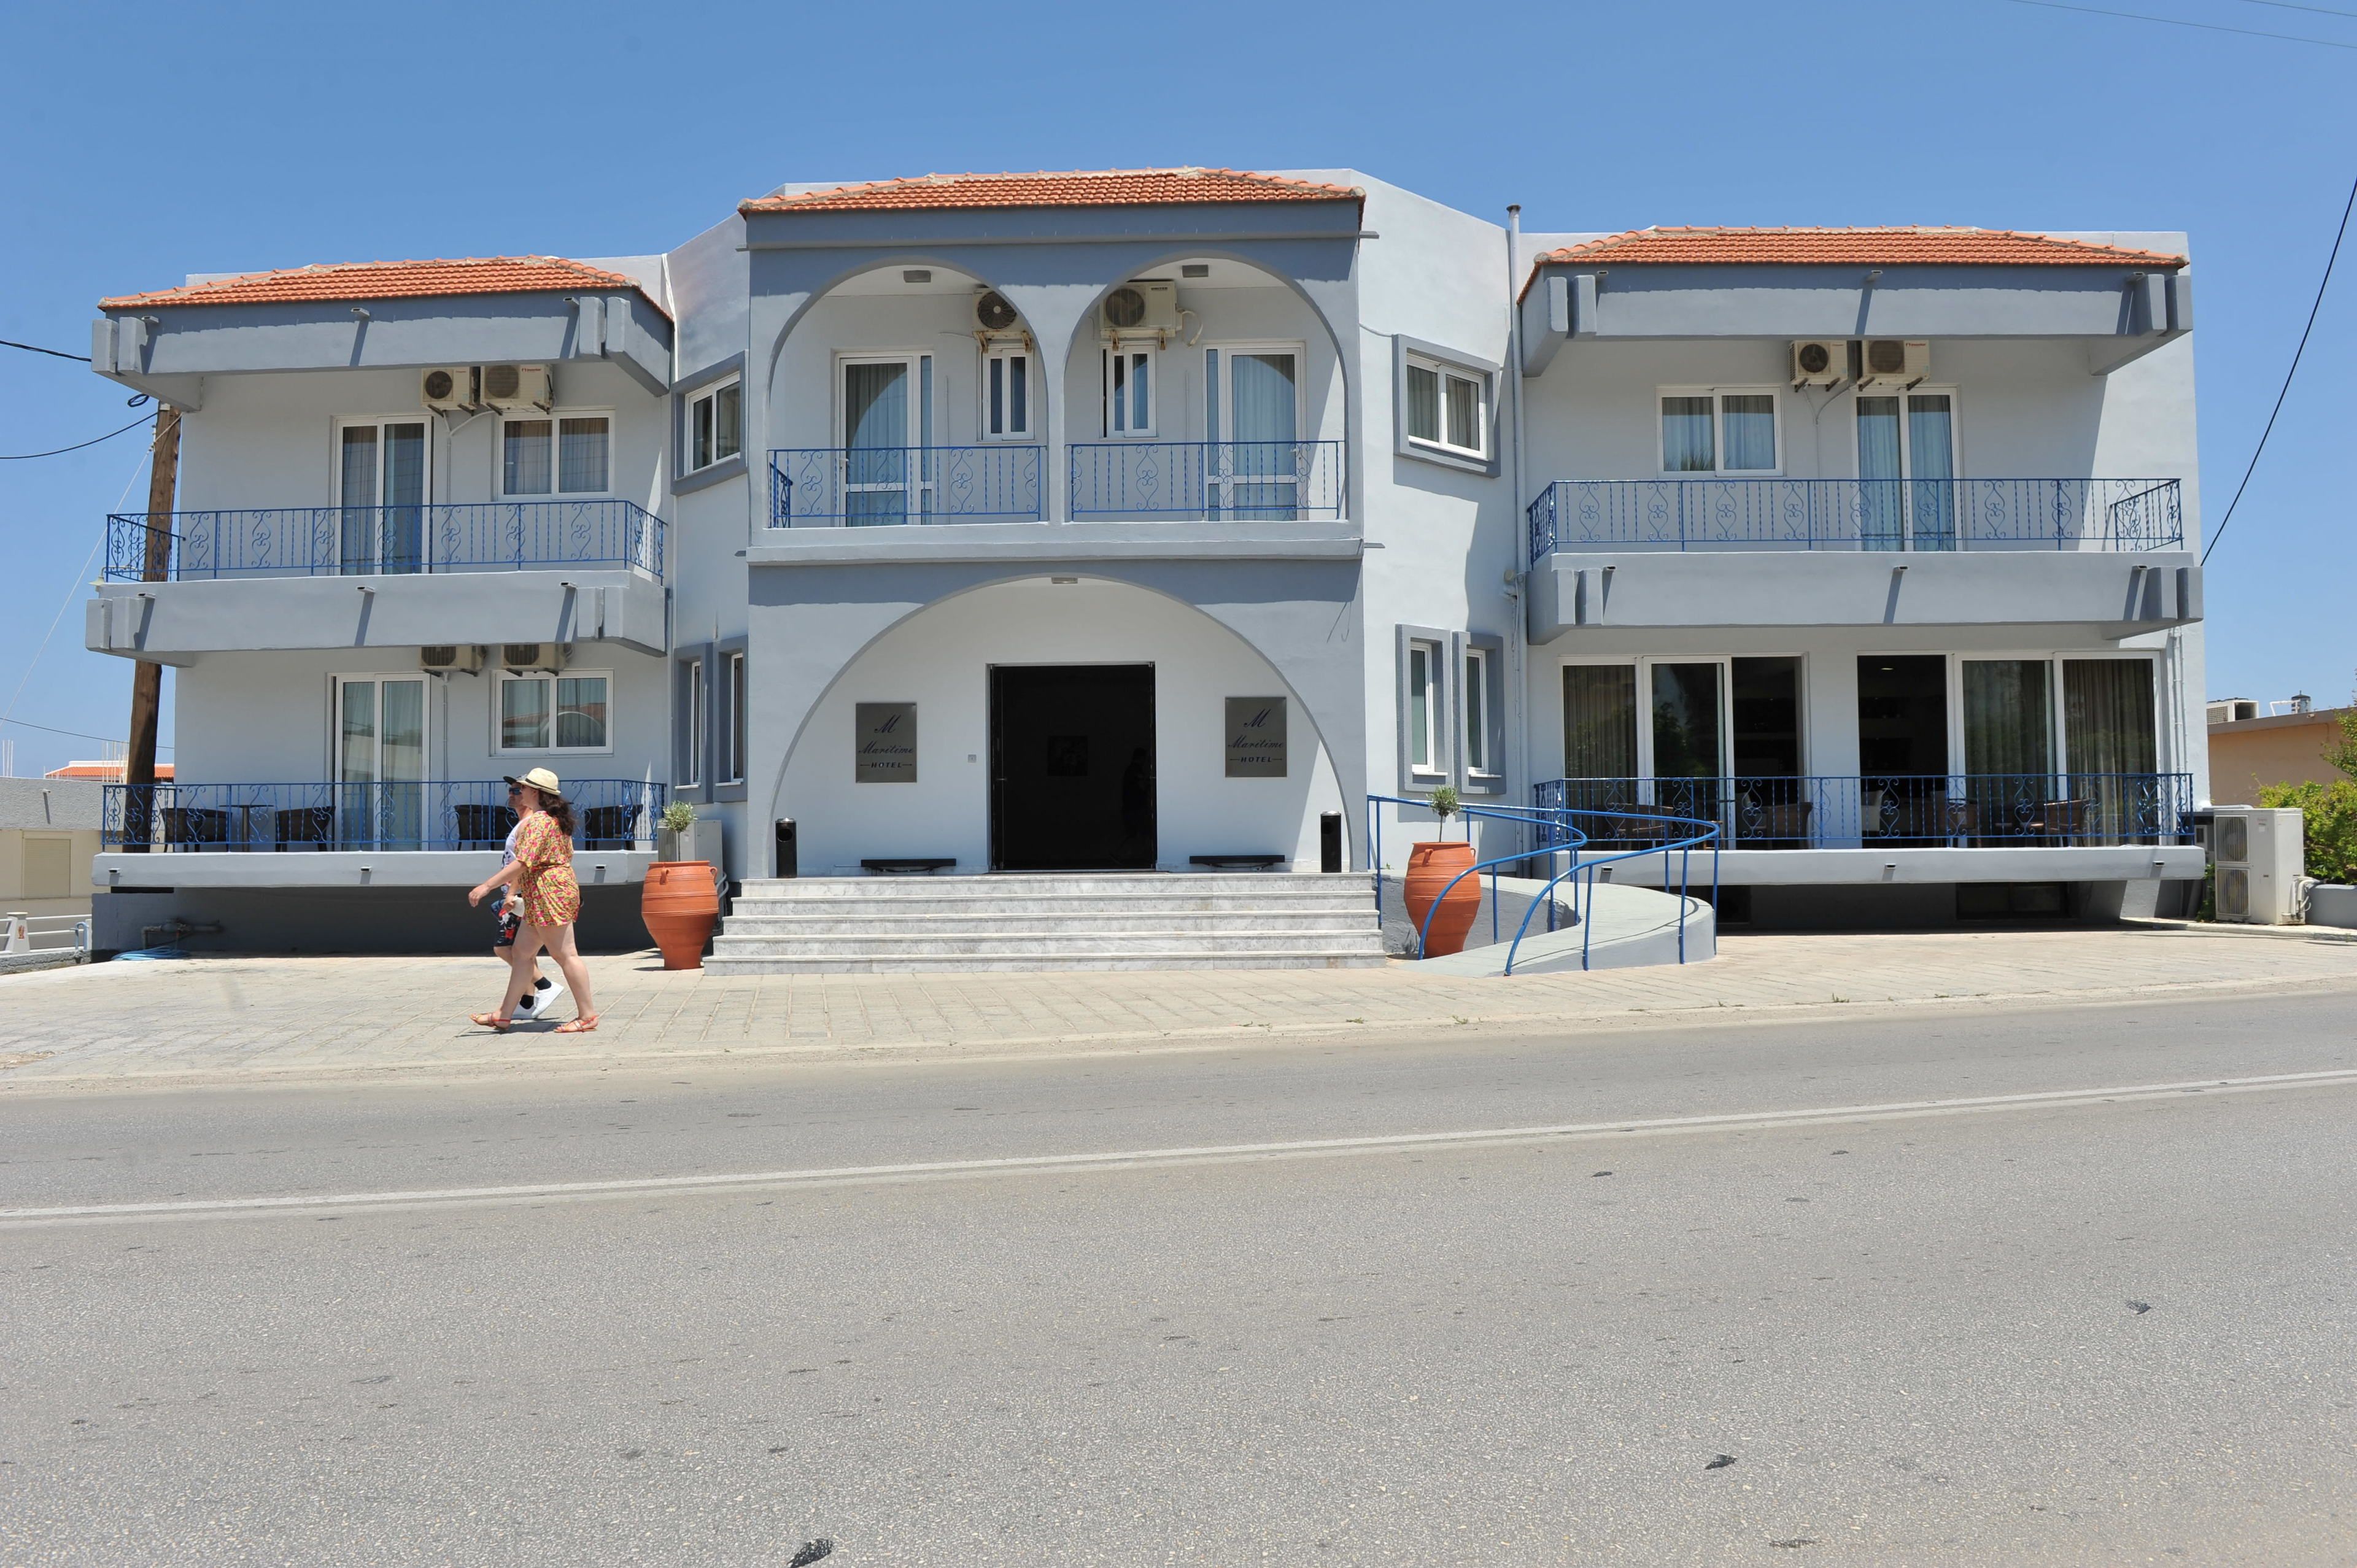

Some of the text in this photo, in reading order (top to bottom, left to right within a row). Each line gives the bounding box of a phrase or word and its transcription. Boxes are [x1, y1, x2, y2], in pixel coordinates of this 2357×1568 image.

[874, 714, 901, 733] M
[1243, 708, 1271, 728] M
[859, 740, 914, 754] Maritime
[1228, 735, 1283, 748] Maritime
